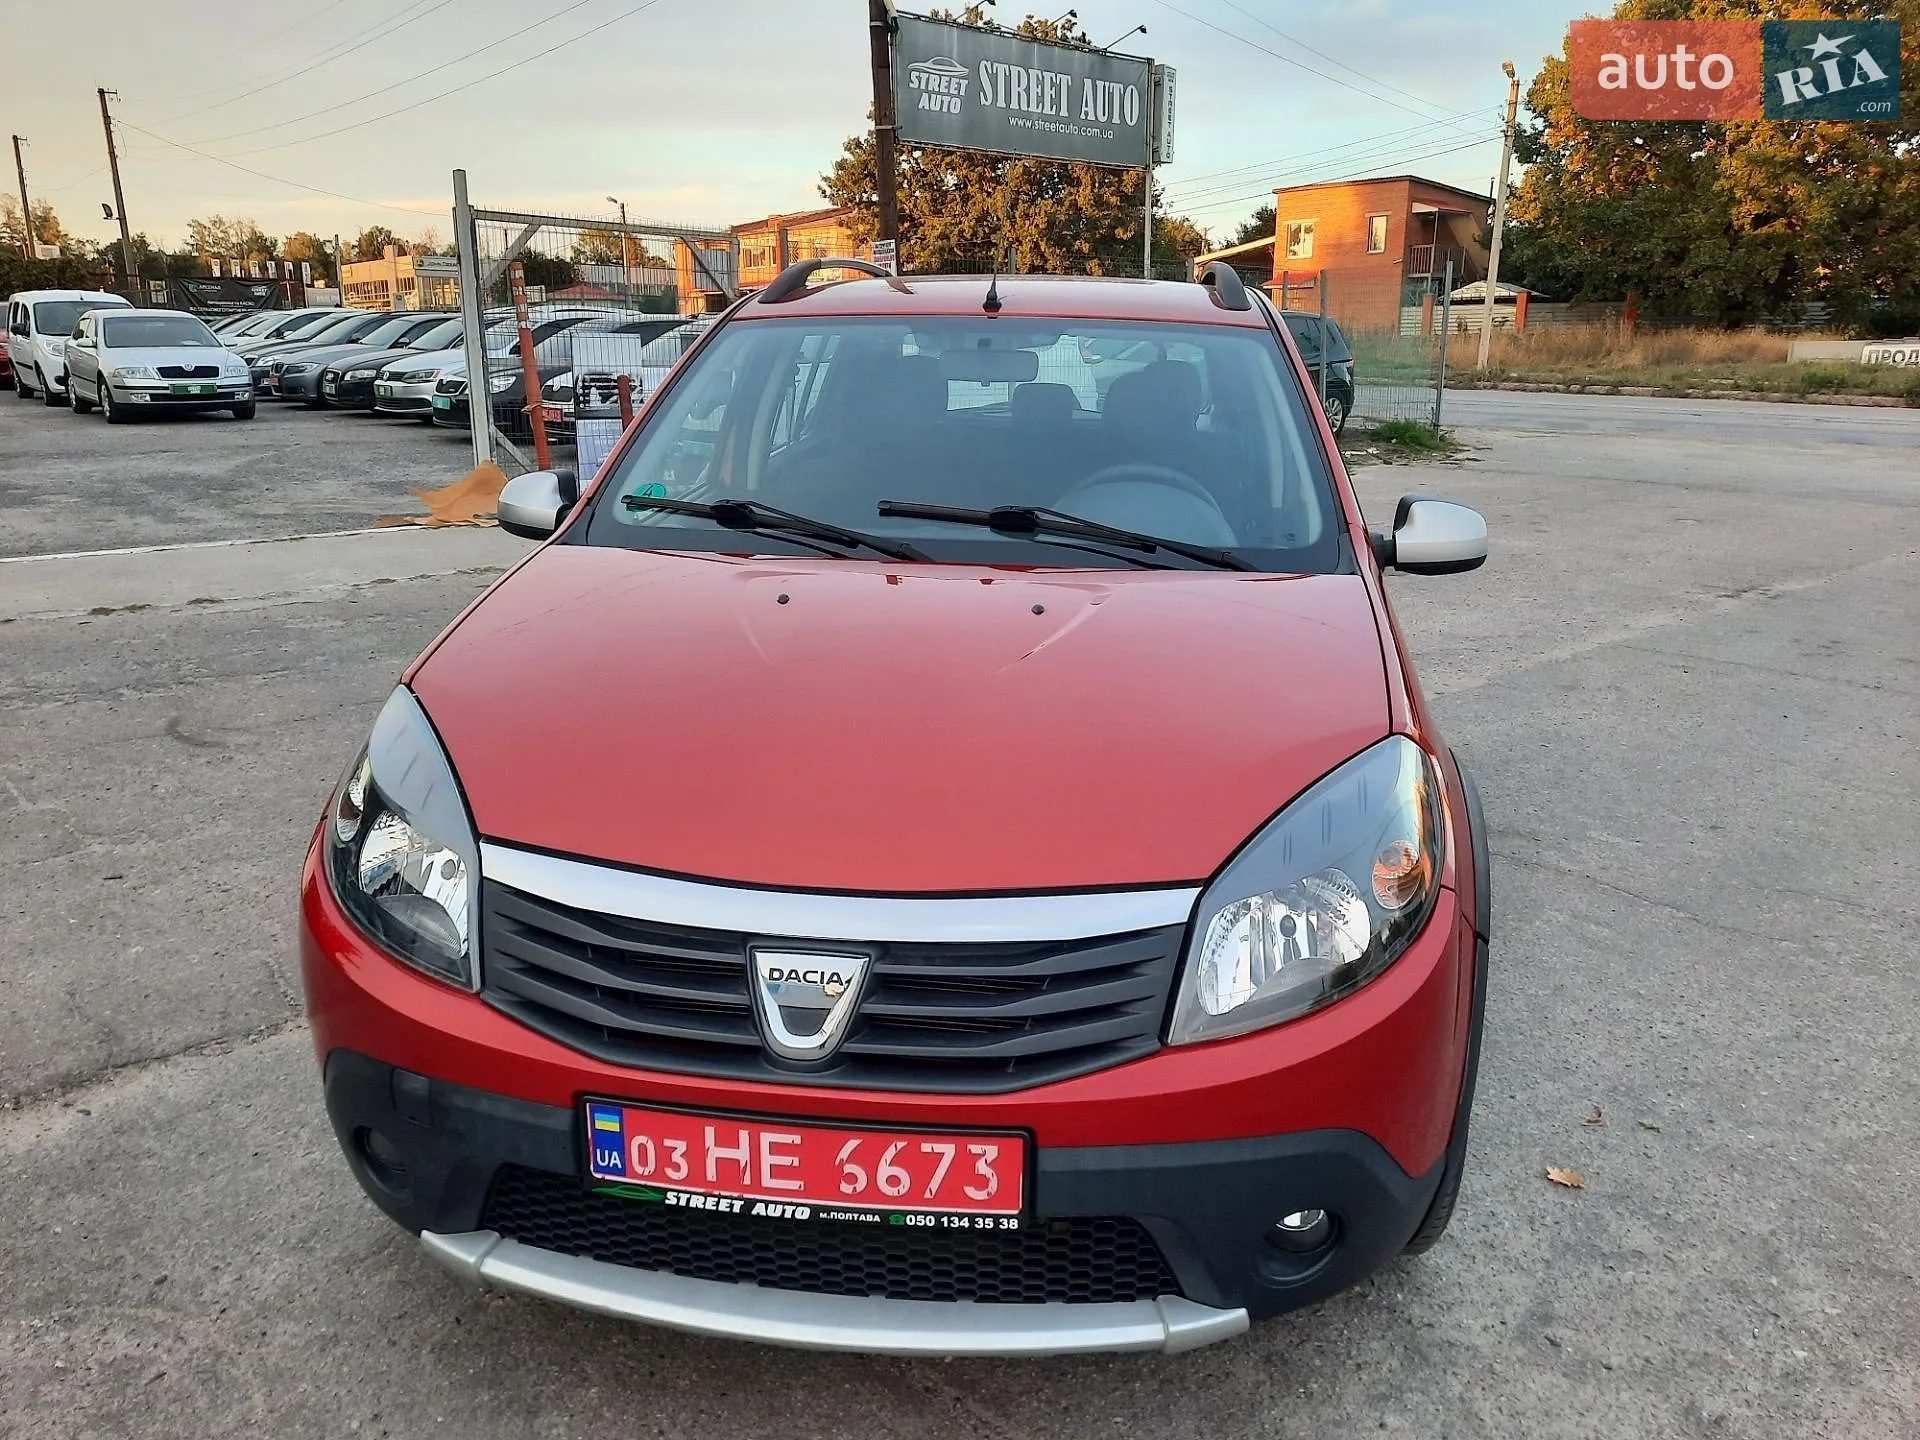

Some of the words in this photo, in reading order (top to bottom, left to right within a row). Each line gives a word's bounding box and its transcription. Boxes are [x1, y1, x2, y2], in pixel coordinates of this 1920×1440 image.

[909, 71, 969, 96] STREET
[979, 59, 1072, 117] STREET
[1080, 78, 1140, 127] AUTO
[918, 92, 961, 114] AUTO
[1008, 116, 1114, 139] www.streetauto.com.ua
[768, 967, 844, 986] DACIA
[596, 1148, 622, 1169] UA
[630, 1135, 689, 1180] 03
[704, 1126, 804, 1190] HE
[835, 1139, 999, 1201] 6673
[664, 1190, 744, 1213] STREET
[751, 1202, 811, 1220] AUTO
[905, 1214, 935, 1228] 050
[940, 1215, 970, 1229] 134
[974, 1217, 994, 1230] 35
[998, 1218, 1019, 1230] 38
